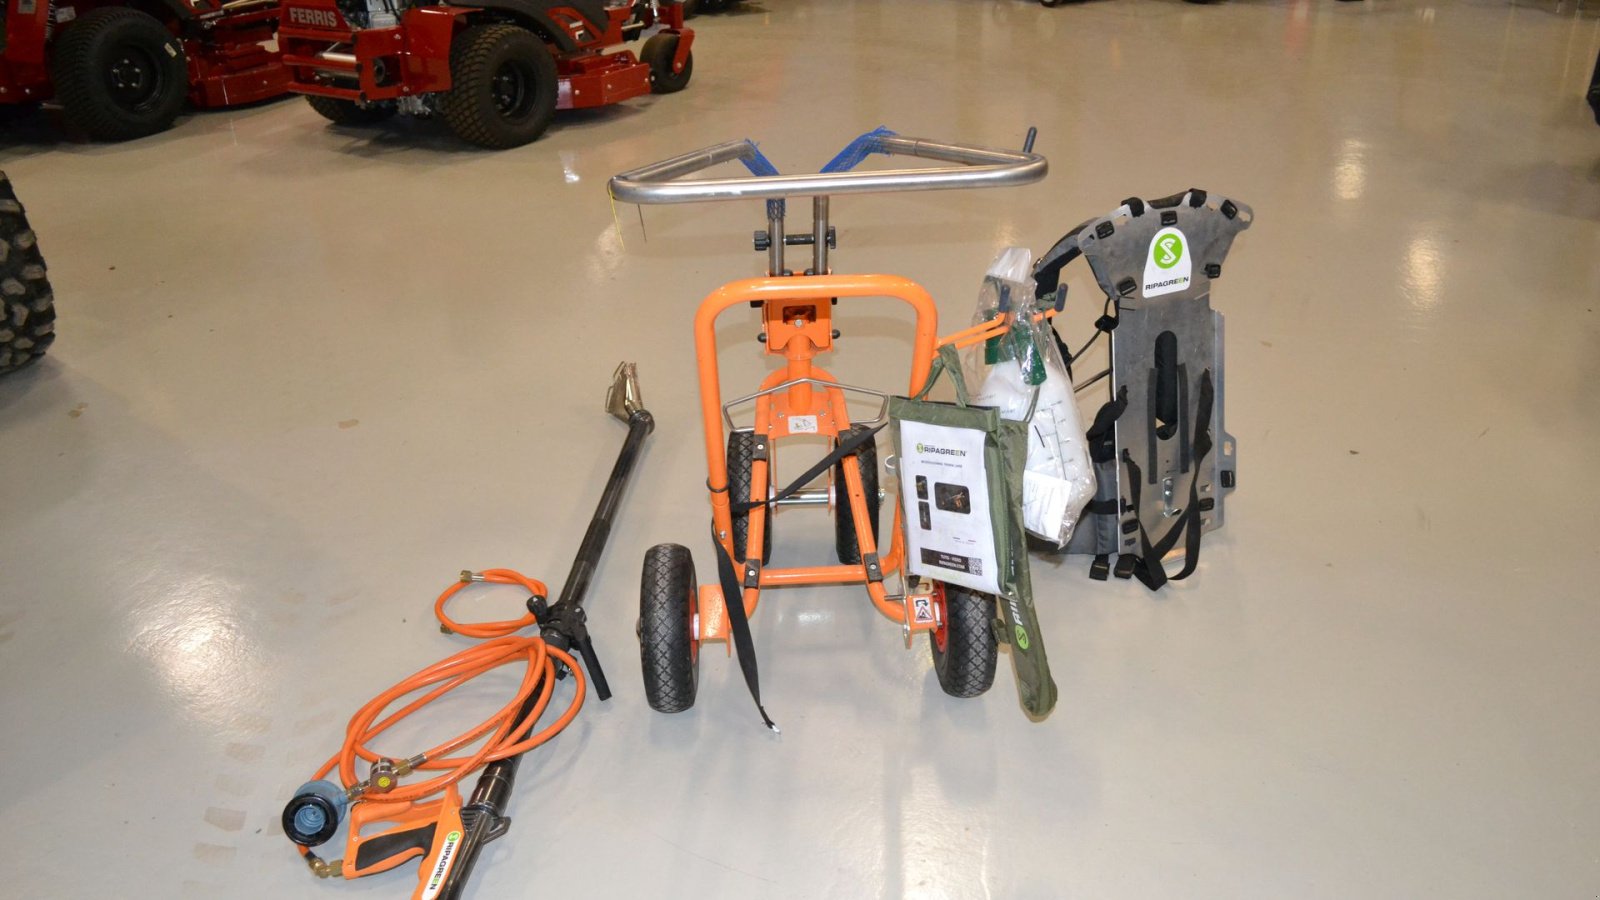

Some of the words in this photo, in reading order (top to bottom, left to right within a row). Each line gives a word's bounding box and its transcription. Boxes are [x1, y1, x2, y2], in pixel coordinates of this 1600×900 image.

[289, 7, 337, 27] FERRIS
[1145, 277, 1189, 291] RIPAGREEN
[923, 446, 966, 457] RIPAGREEN
[429, 842, 454, 890] RIPAGREEN
